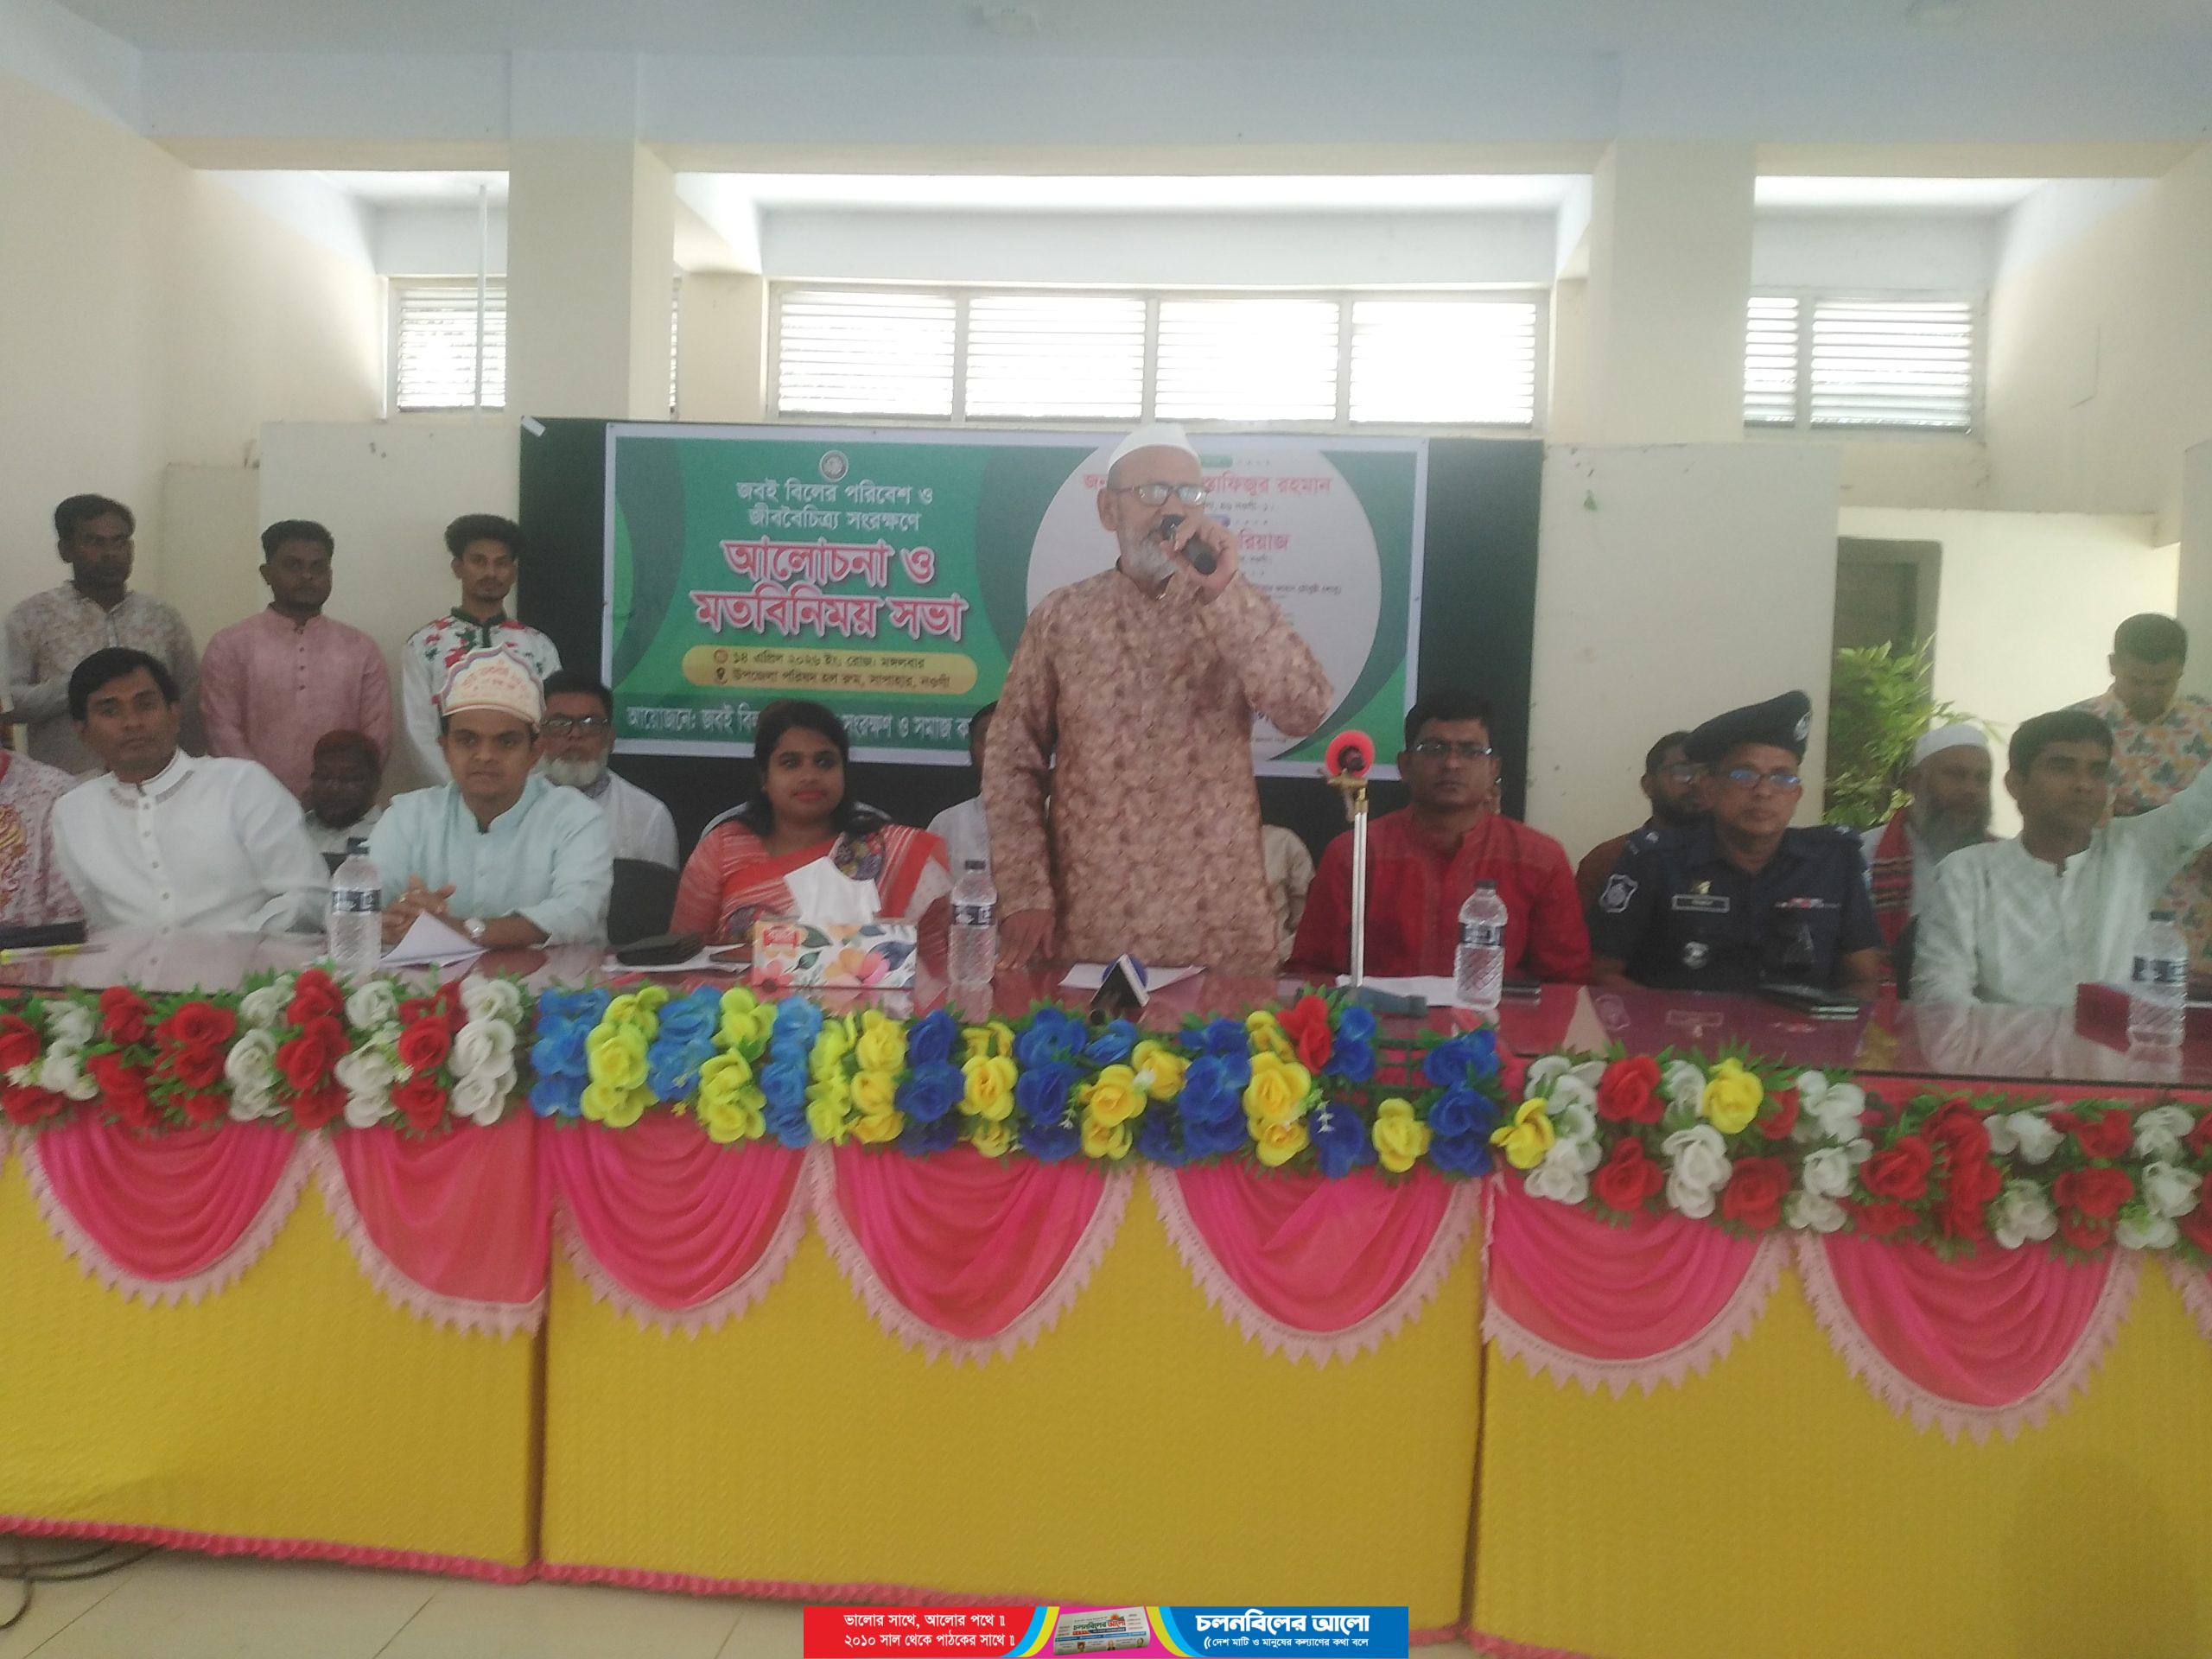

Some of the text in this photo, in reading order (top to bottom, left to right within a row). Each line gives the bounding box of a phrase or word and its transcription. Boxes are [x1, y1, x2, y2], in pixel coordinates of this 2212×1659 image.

[736, 478, 933, 505] জবই বিলের পরিবেশ ও
[1277, 477, 1333, 493] রহমান
[847, 512, 922, 531] সংরক্ষণে
[719, 535, 935, 588] আলোচনা ও
[690, 580, 969, 642] মতবিনিময় সভা
[733, 652, 748, 664] ১৪
[753, 649, 784, 663] এপ্রিল
[733, 667, 779, 681] উপজেলা
[782, 669, 817, 683] পরিষদ
[701, 702, 734, 734] জবই
[899, 716, 908, 738] ও
[913, 716, 953, 740] সমাজ
